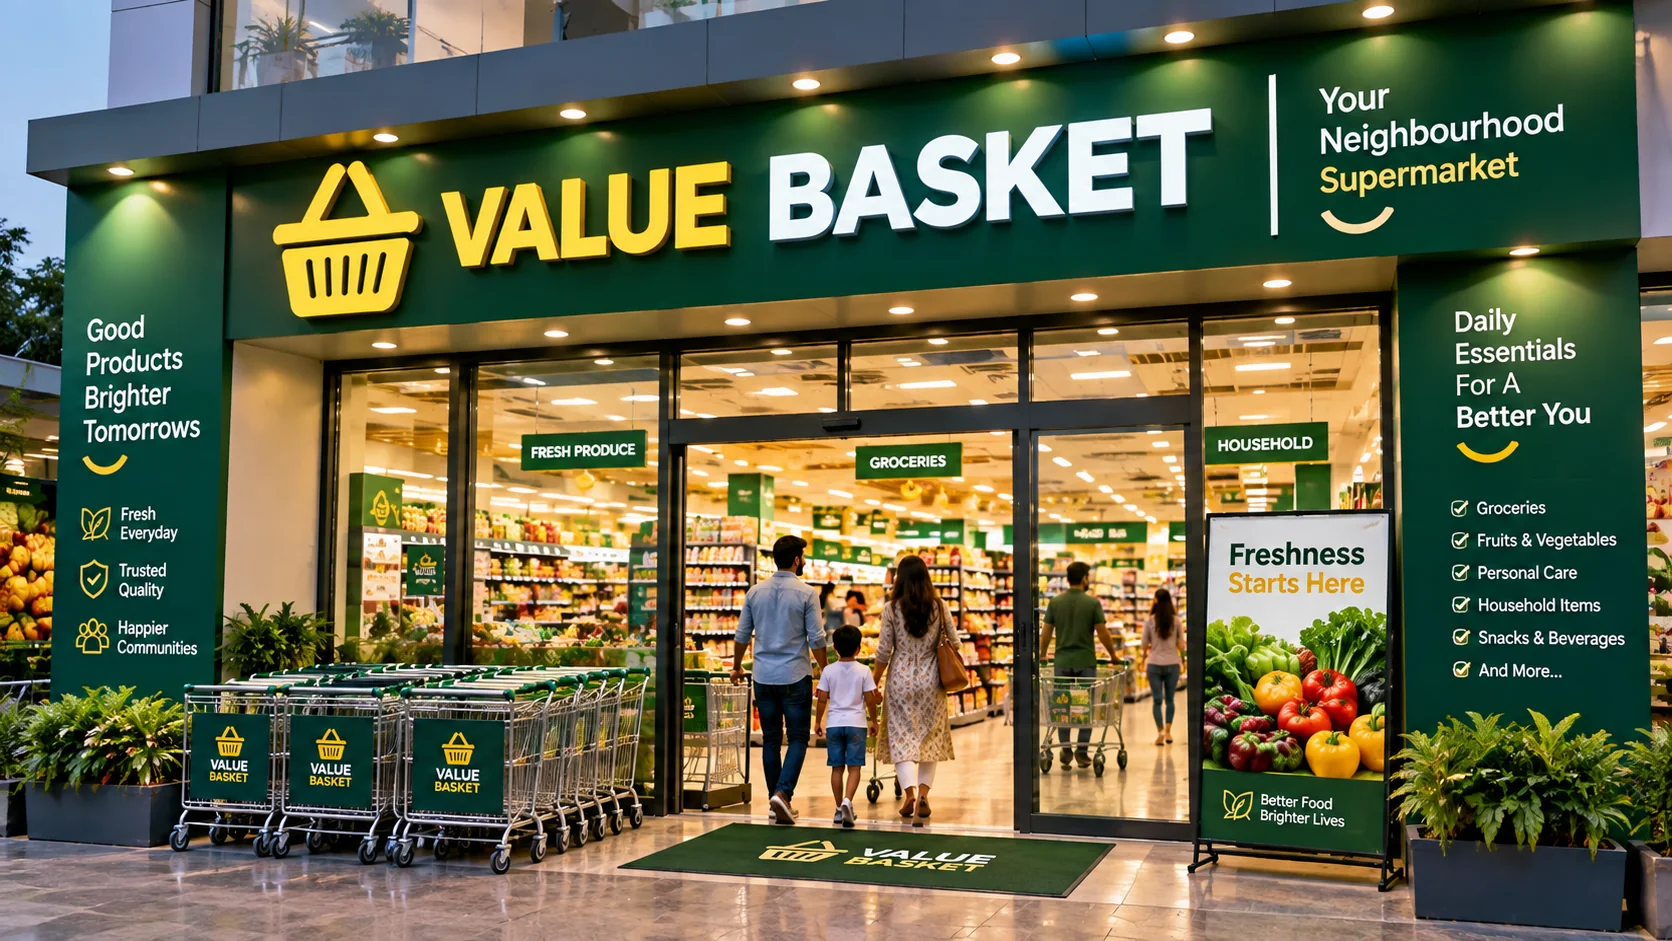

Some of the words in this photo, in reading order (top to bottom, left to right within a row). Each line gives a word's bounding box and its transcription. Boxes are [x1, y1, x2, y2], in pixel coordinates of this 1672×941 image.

[1319, 86, 1390, 115] Your
[1320, 103, 1565, 156] Neighbourhood
[1320, 151, 1519, 197] Supermarket
[440, 160, 732, 269] VALUE
[768, 107, 1214, 244] BASKET
[86, 314, 145, 343] Good
[1454, 308, 1517, 335] Daily
[1455, 337, 1577, 365] Essentials
[86, 347, 183, 376] Products
[1456, 374, 1496, 397] For
[1502, 371, 1521, 394] A
[84, 383, 172, 414] Brighter
[1456, 405, 1536, 429] Better
[1541, 402, 1591, 425] You
[83, 416, 201, 443] Tomorrows
[530, 444, 572, 459] FRESH
[574, 442, 636, 458] PRODUCE
[1217, 436, 1313, 452] HOUSEHOLD
[869, 454, 947, 469] GROCERIES
[121, 505, 156, 522] Fresh
[1476, 500, 1546, 516] Groceries
[120, 526, 178, 543] Everyday
[1477, 533, 1517, 549] Fruits
[1521, 533, 1533, 548] &
[1536, 532, 1617, 550] Vegetables
[1229, 541, 1365, 566] Freshness
[119, 563, 167, 578] Trusted
[1477, 565, 1540, 581] Personal
[1543, 565, 1578, 580] Care
[118, 582, 164, 600] Quality
[1228, 571, 1299, 595] Starts
[1306, 571, 1365, 594] Here
[1478, 597, 1556, 613] Household
[1560, 597, 1601, 613] Items
[117, 620, 168, 638] Happier
[117, 640, 198, 656] Communities
[1478, 630, 1530, 646] Snacks
[1533, 630, 1545, 646] &
[1548, 630, 1625, 649] Beverages
[1478, 662, 1508, 679] And
[1512, 662, 1563, 679] More...
[210, 758, 248, 772] VALUE
[310, 762, 352, 776] VALUE
[208, 771, 249, 783] BASKET
[309, 775, 352, 788] BASKET
[435, 767, 480, 782] VALUE
[434, 780, 481, 794] BASKET
[1260, 793, 1299, 808] Better
[1301, 795, 1333, 810] Food
[1260, 808, 1310, 826] Brighter
[1313, 812, 1345, 828] Lives
[863, 847, 997, 865] VALUE
[845, 858, 985, 873] BASKET
